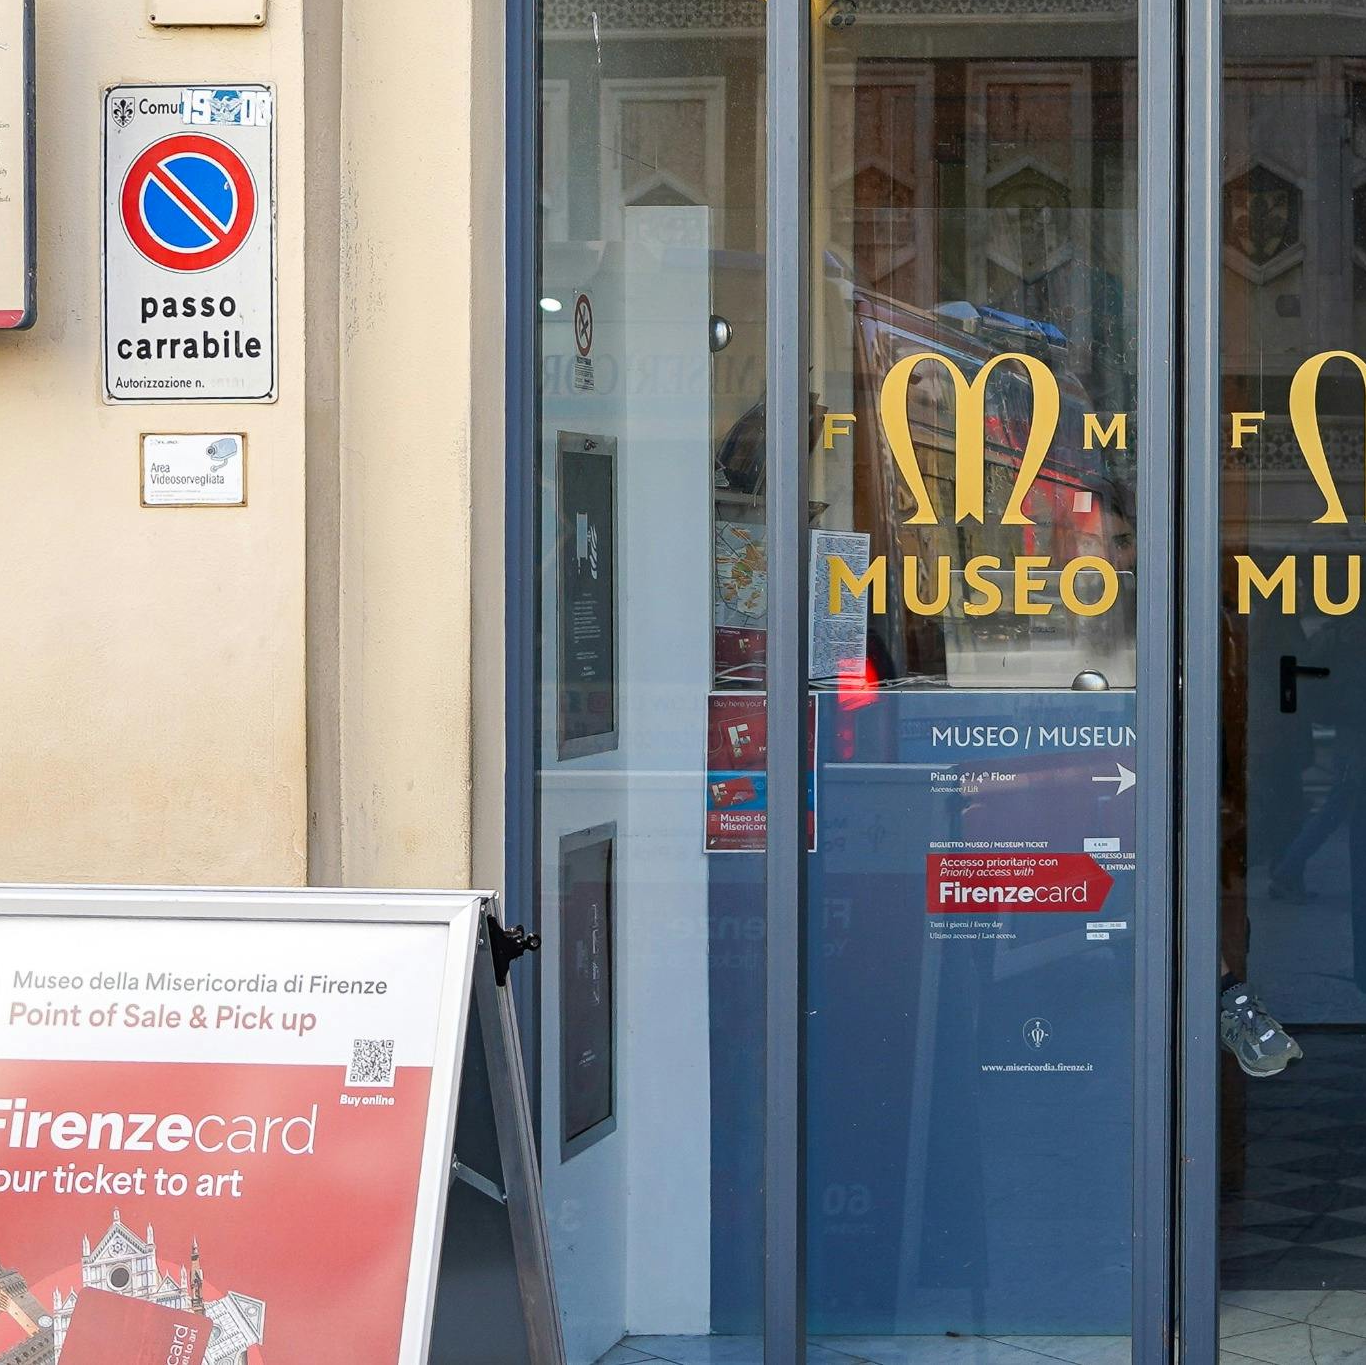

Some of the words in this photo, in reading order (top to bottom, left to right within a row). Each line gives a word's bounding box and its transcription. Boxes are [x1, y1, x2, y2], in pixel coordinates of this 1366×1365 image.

[139, 99, 179, 114] Comu
[140, 295, 236, 324] passo
[117, 334, 262, 360] carrabile
[116, 376, 191, 388] Autorizzazione
[823, 413, 857, 449] F
[1083, 413, 1127, 451] M
[1230, 410, 1265, 448] F
[150, 463, 170, 473] Area
[150, 474, 224, 486] Videosorvegliata
[826, 555, 1119, 617] MUSEO
[932, 726, 1019, 747] MUSEO
[931, 772, 958, 782] Piano
[991, 772, 1016, 782] Floor
[720, 814, 751, 822] Museo
[940, 858, 984, 867] Accesso
[987, 857, 1035, 868] prioritario
[940, 868, 974, 878] Priority
[1014, 868, 1034, 876] with
[940, 881, 1087, 903] Firenzecard
[974, 921, 991, 930] Every
[992, 921, 1003, 929] day
[12, 970, 83, 990] Museo
[89, 971, 138, 991] della
[145, 972, 277, 994] Misericordia
[284, 974, 303, 994] di
[309, 975, 388, 995] Firenze
[9, 1002, 81, 1027] Point
[89, 1003, 118, 1028] of
[123, 1003, 181, 1029] Sale
[189, 1004, 208, 1029] &
[216, 1005, 273, 1030] Pick
[281, 1012, 317, 1036] up
[981, 1063, 1093, 1071] www.misericordia.firenze.it
[340, 1095, 360, 1107] Buy
[362, 1095, 395, 1107] online
[53, 1162, 147, 1195] ticket
[154, 1168, 187, 1196] to
[195, 1169, 243, 1197] art
[189, 1329, 198, 1342] art
